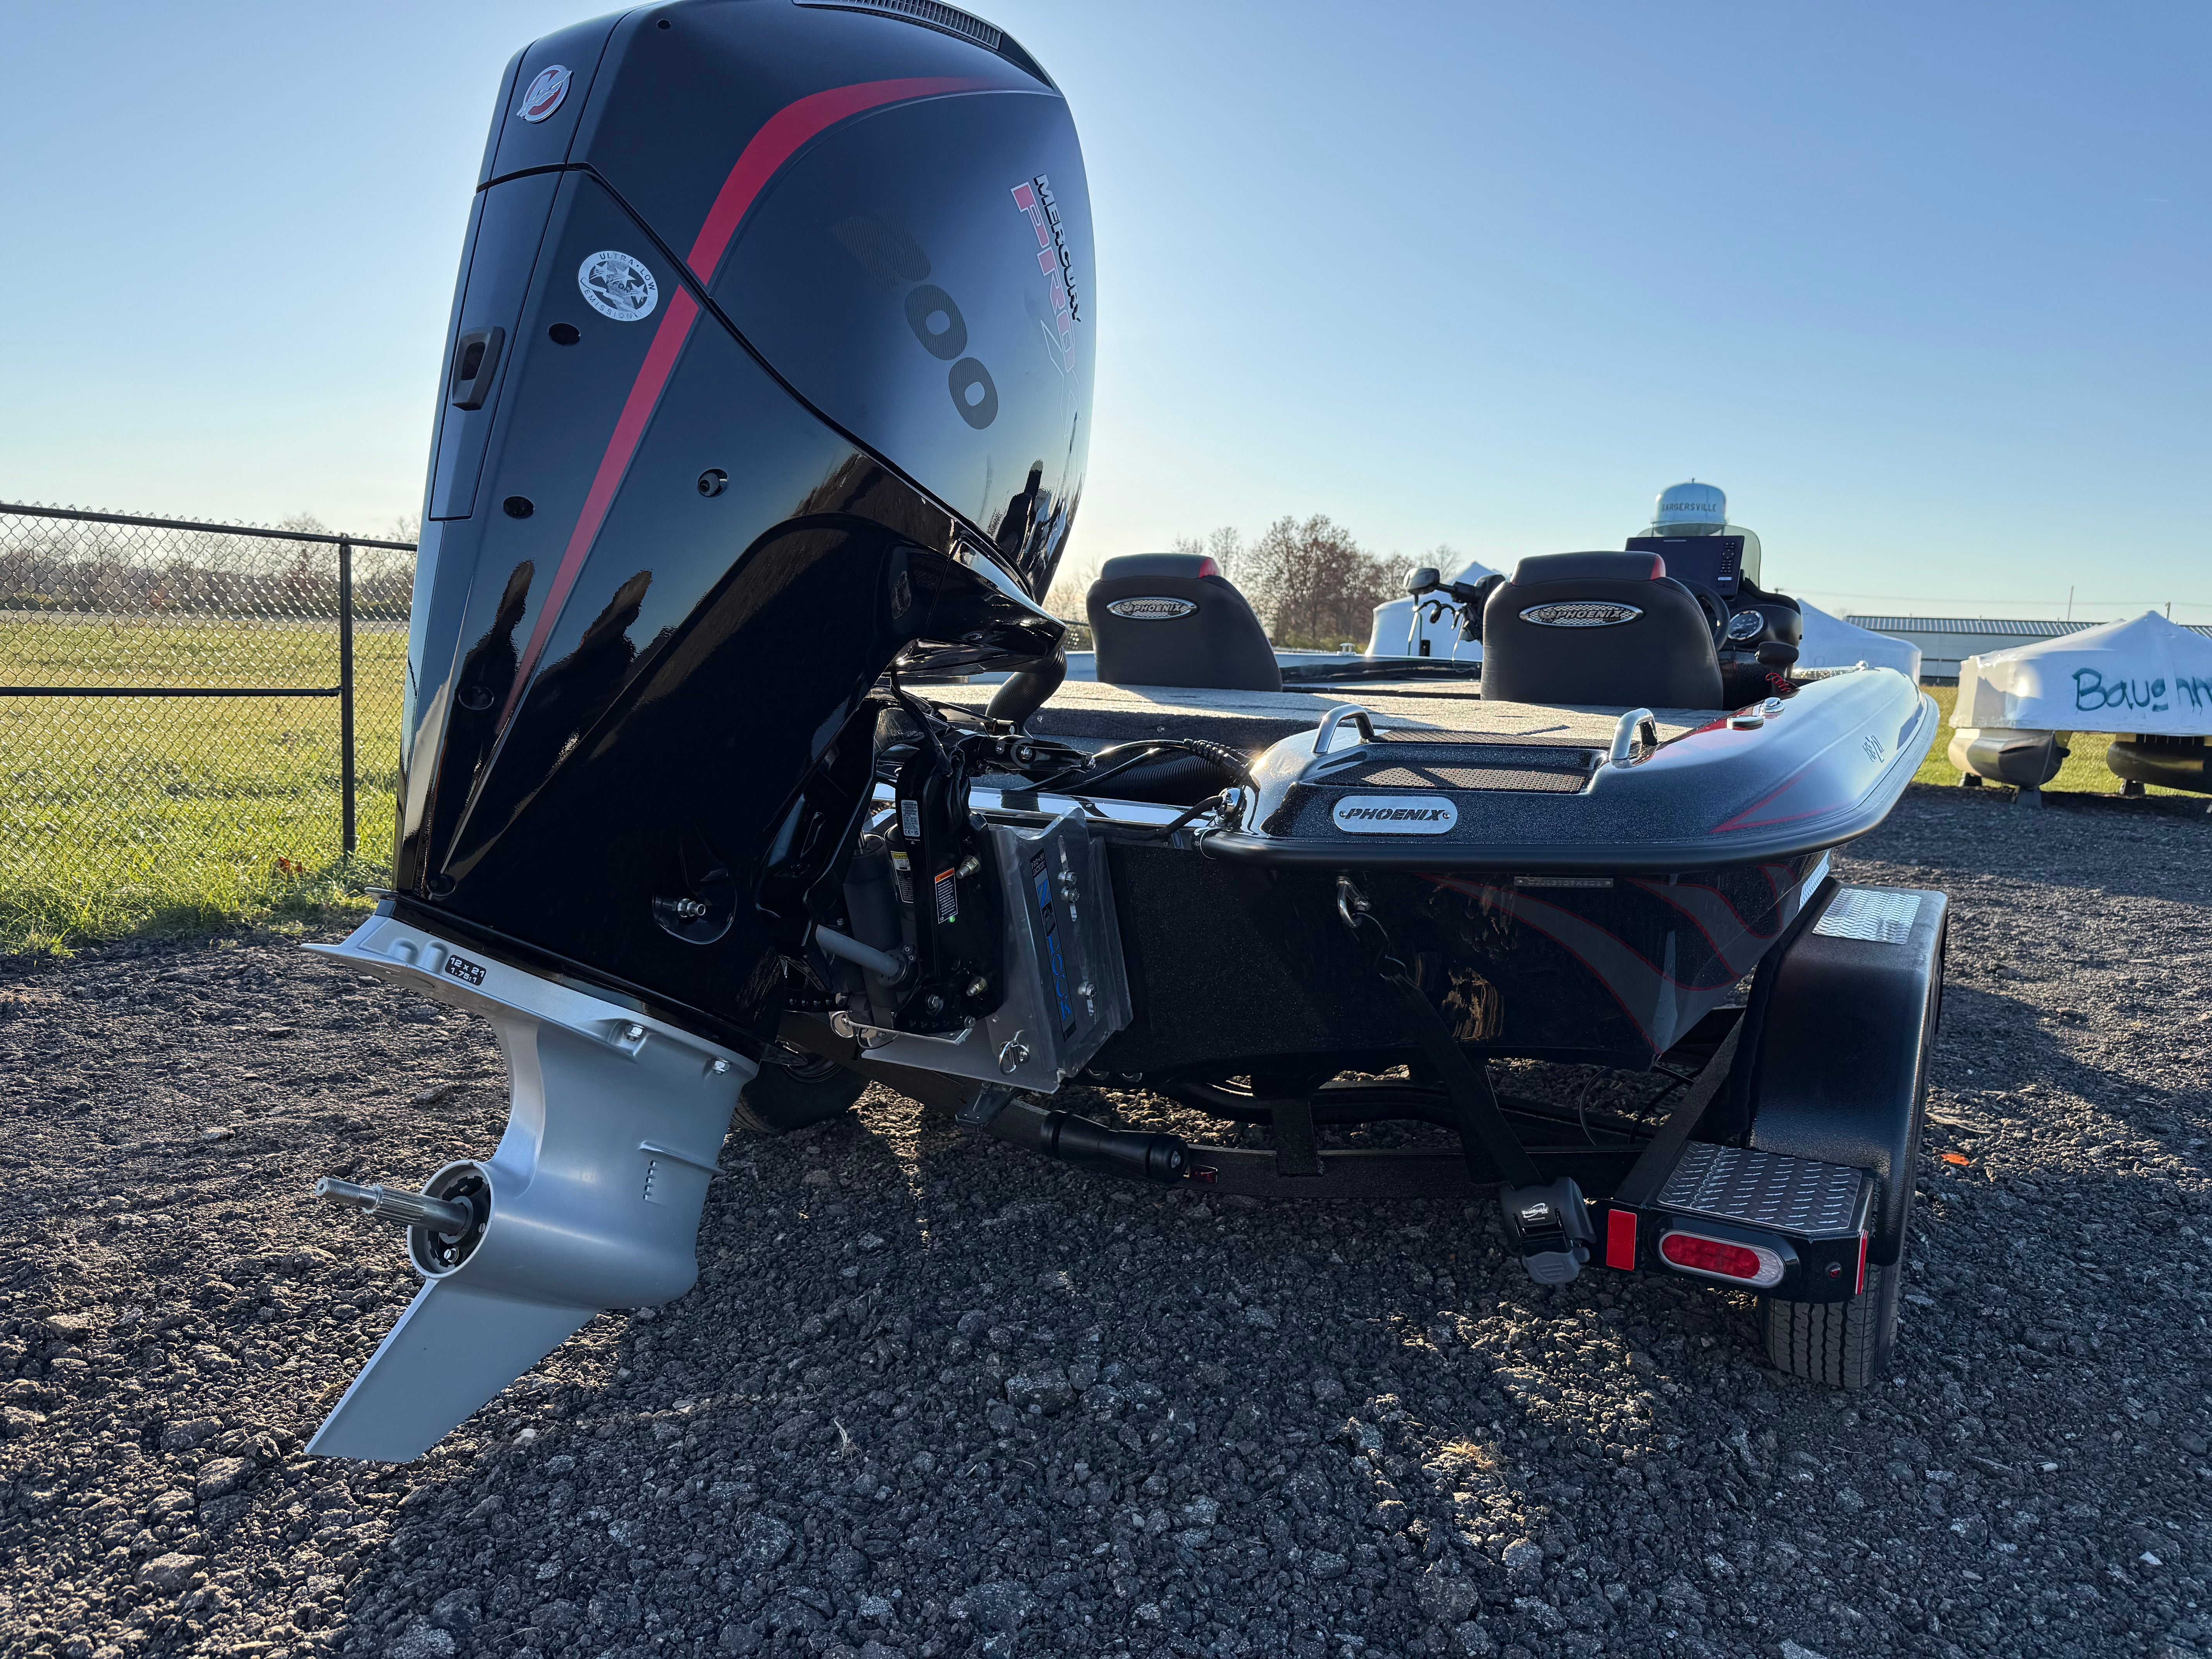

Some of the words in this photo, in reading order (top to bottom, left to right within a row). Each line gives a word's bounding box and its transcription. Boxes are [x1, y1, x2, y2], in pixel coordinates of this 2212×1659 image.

[1033, 173, 1081, 322] MERCURY
[599, 252, 634, 266] ULTRA
[639, 268, 656, 290] LOW
[1011, 181, 1075, 373] PRO
[584, 289, 632, 319] EMISSION
[1661, 502, 1717, 512] BARGERSVILLE
[1556, 610, 1623, 619] PHOENIX
[1345, 808, 1446, 821] PHOENIX
[450, 957, 463, 968] 12
[471, 967, 485, 977] 21
[451, 967, 477, 983] 1.75:1
[1046, 933, 1072, 1022] LOCK
